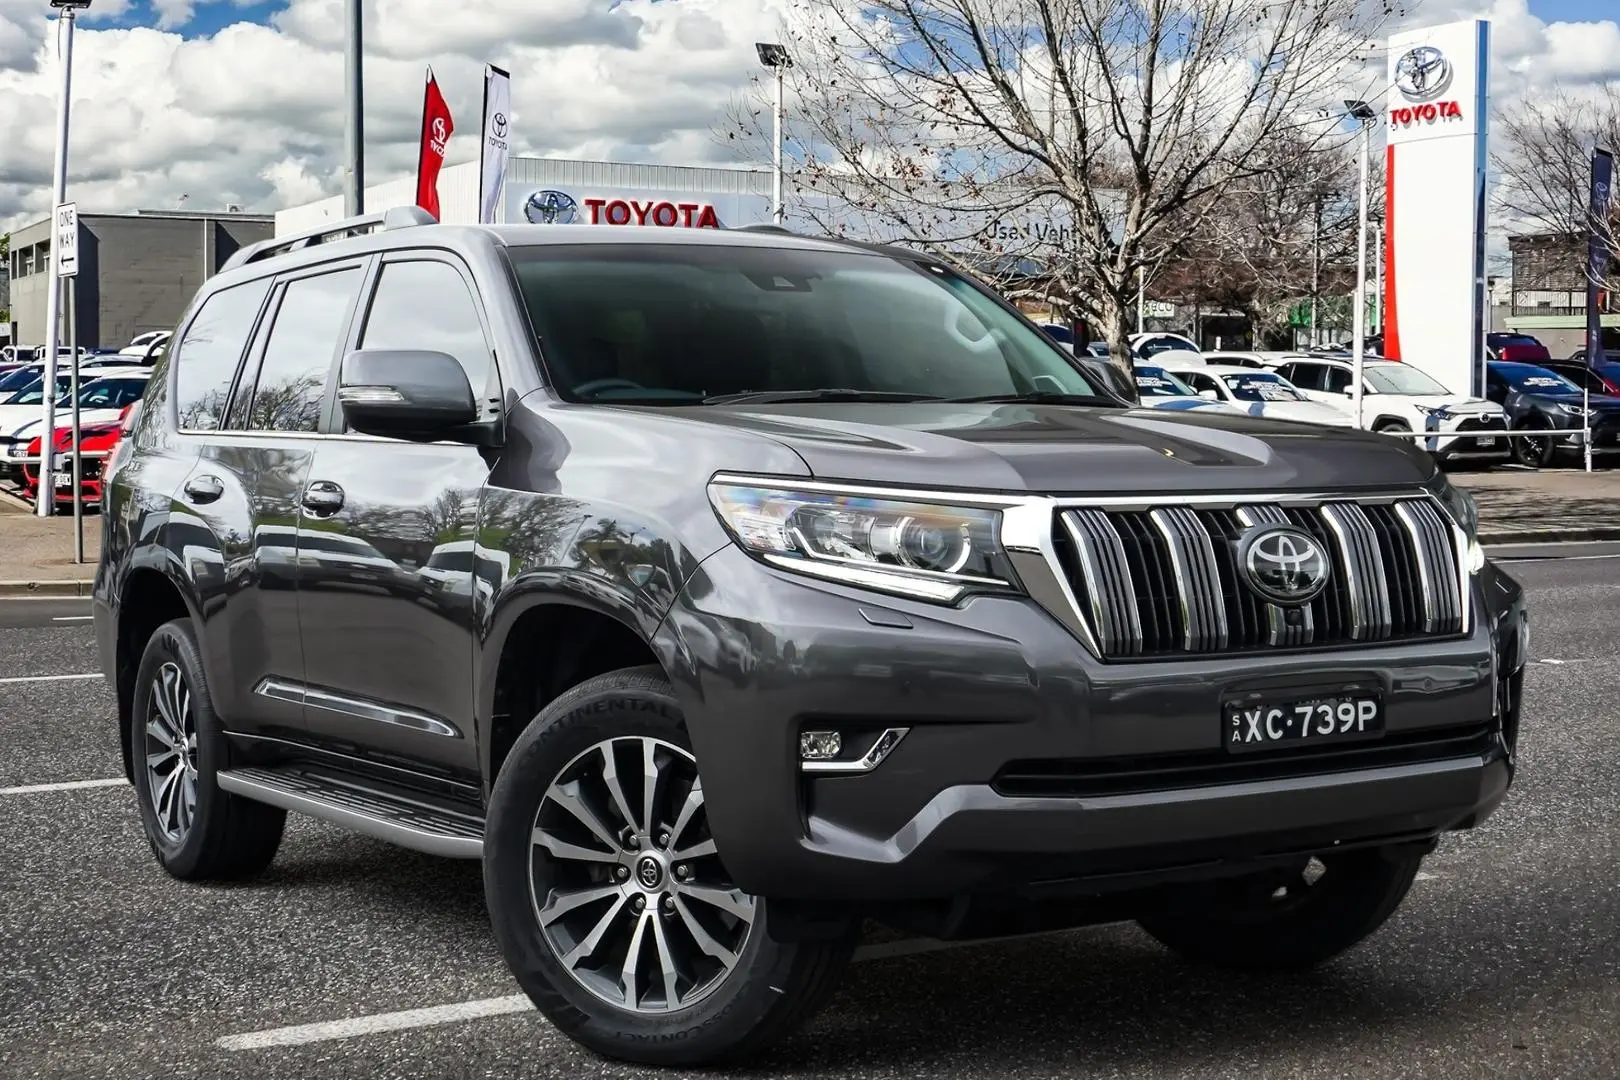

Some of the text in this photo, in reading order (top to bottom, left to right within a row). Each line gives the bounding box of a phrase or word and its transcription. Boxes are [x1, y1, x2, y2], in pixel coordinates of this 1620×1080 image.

[1389, 101, 1462, 124] TOYOTA
[60, 209, 74, 227] ONE
[584, 199, 720, 229] TOYOTA
[59, 231, 75, 249] WAY
